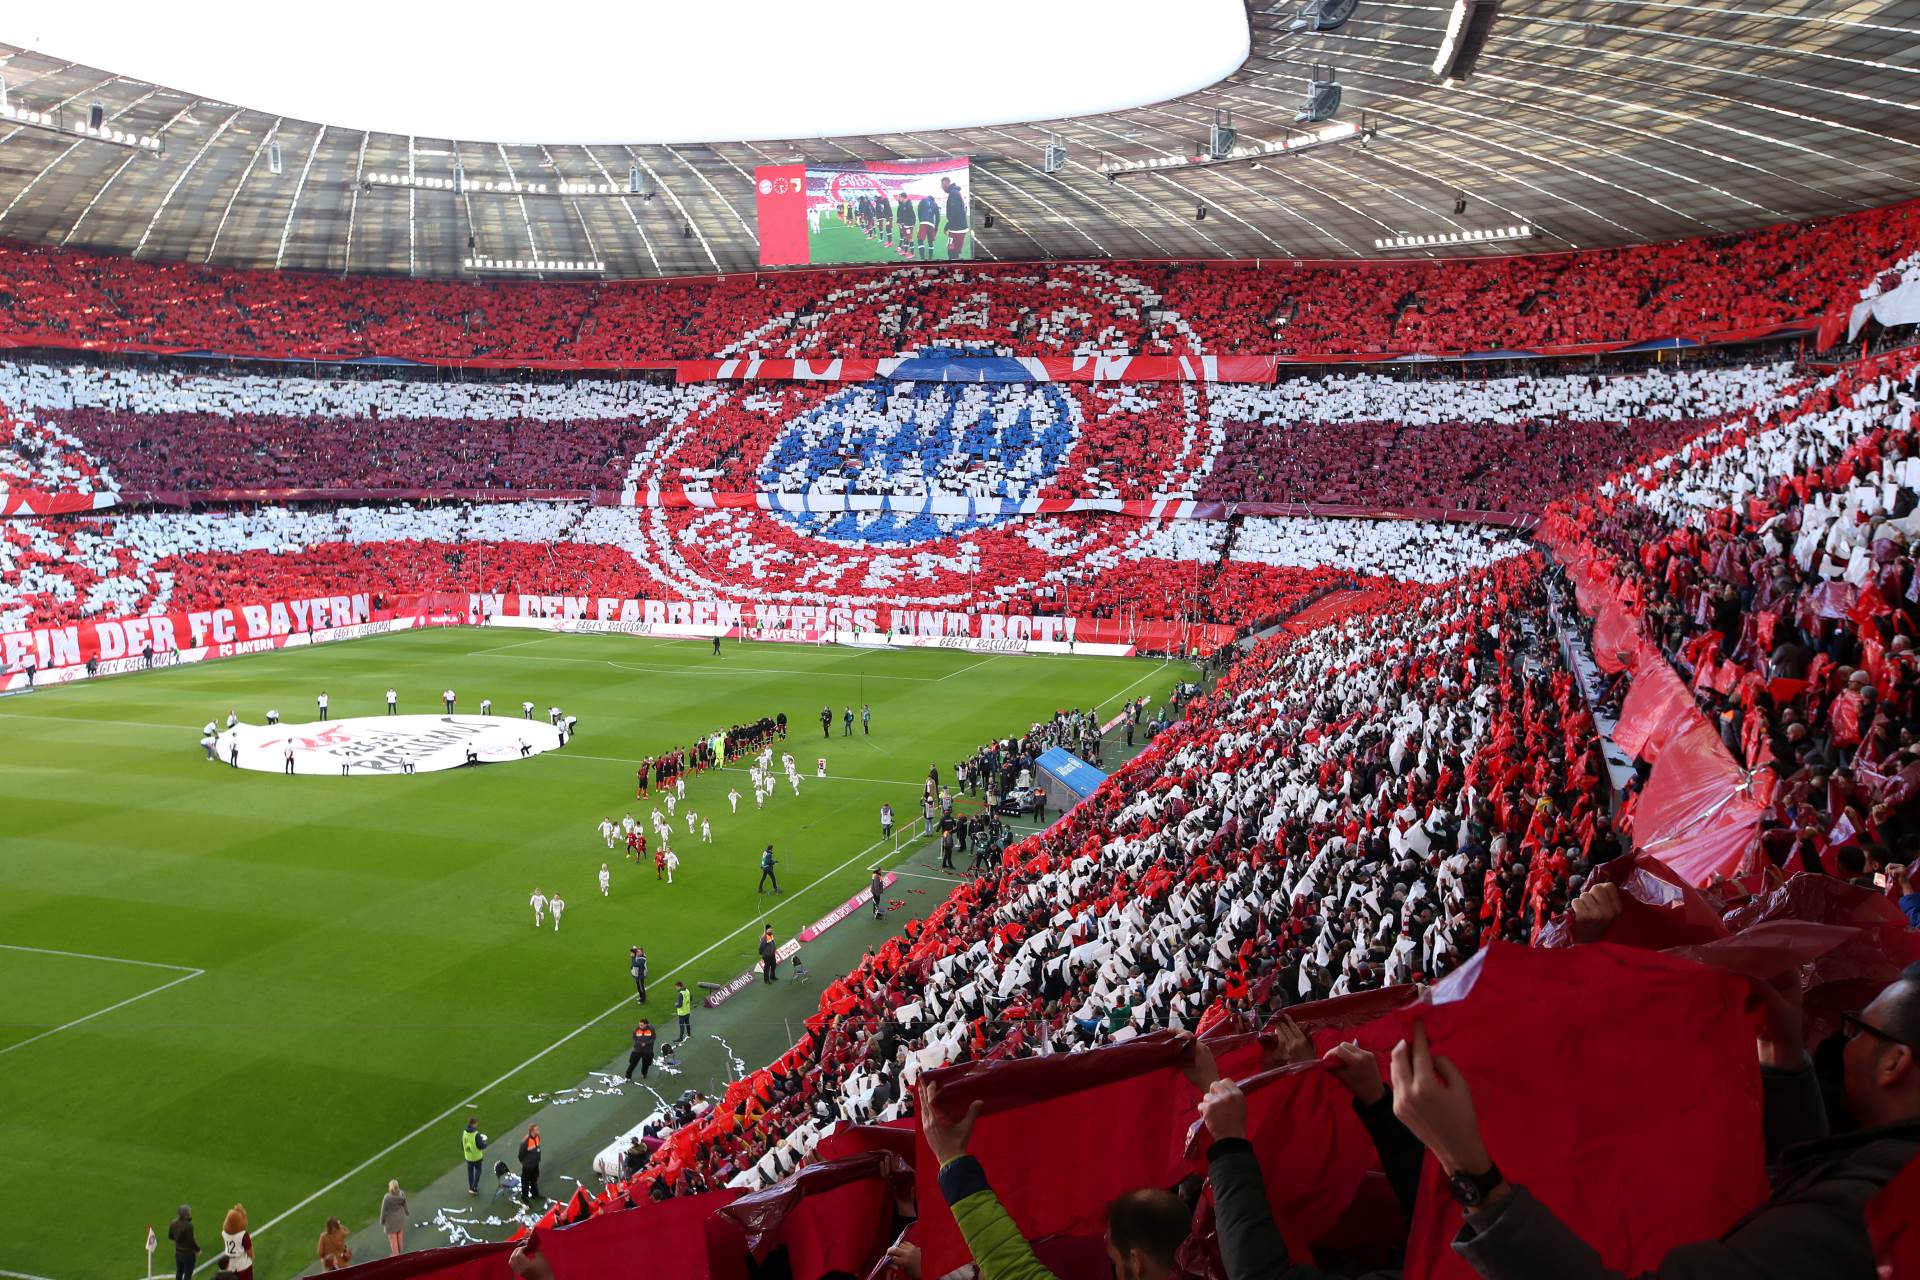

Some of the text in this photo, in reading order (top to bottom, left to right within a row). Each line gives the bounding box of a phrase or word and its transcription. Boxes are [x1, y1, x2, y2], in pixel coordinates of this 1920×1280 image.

[95, 616, 178, 660] DER
[188, 608, 237, 648] FC
[242, 592, 370, 638] BAYERN
[469, 593, 1077, 642] IN DEN FARBEN WEISS UND ROT!
[576, 621, 602, 631] GEGEN
[607, 622, 653, 633] RASSISMUS
[761, 628, 807, 640] BAYERN
[219, 637, 275, 657] FC BAYERN
[939, 637, 970, 648] GEGEN
[975, 638, 1028, 652] RASSISMUS
[710, 972, 753, 1005] QATAR AIRWAYS
[226, 1240, 237, 1254] 12
